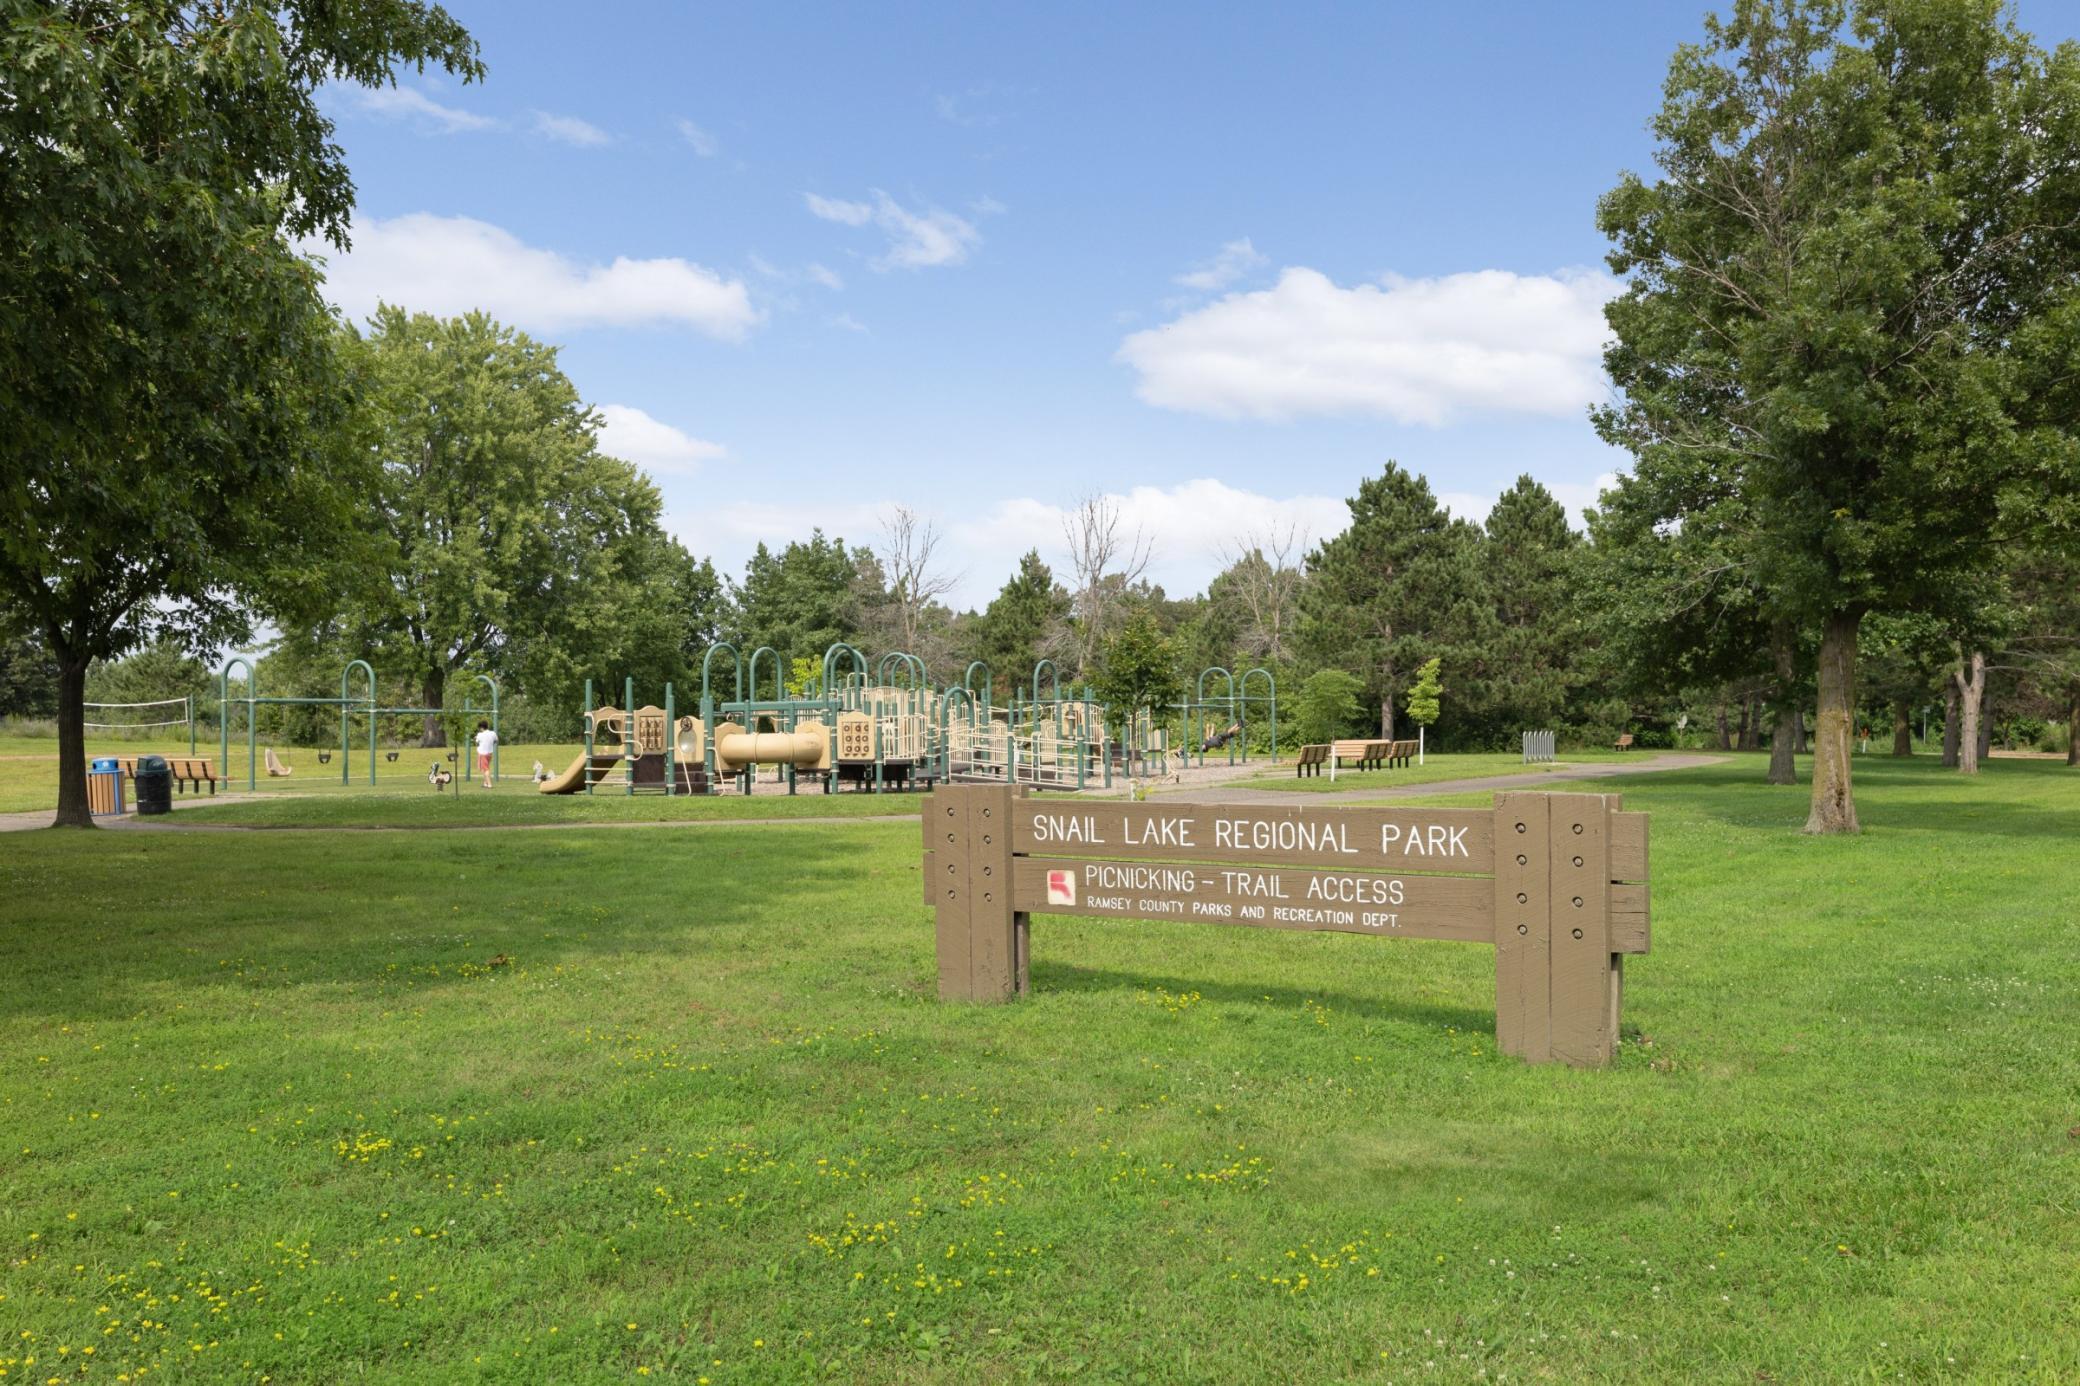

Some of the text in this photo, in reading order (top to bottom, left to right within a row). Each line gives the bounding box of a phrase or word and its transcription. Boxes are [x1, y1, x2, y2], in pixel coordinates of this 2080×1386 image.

[1033, 814, 1469, 857] SNAIL LAKE REGIONAL PARK
[1085, 865, 1195, 893] PICNICKING
[1220, 871, 1289, 898] TRAIL
[1307, 876, 1405, 905] ACCESS
[1087, 895, 1402, 928] RAMSEY COUNTY PARKS AND RECREATION DEPT.
